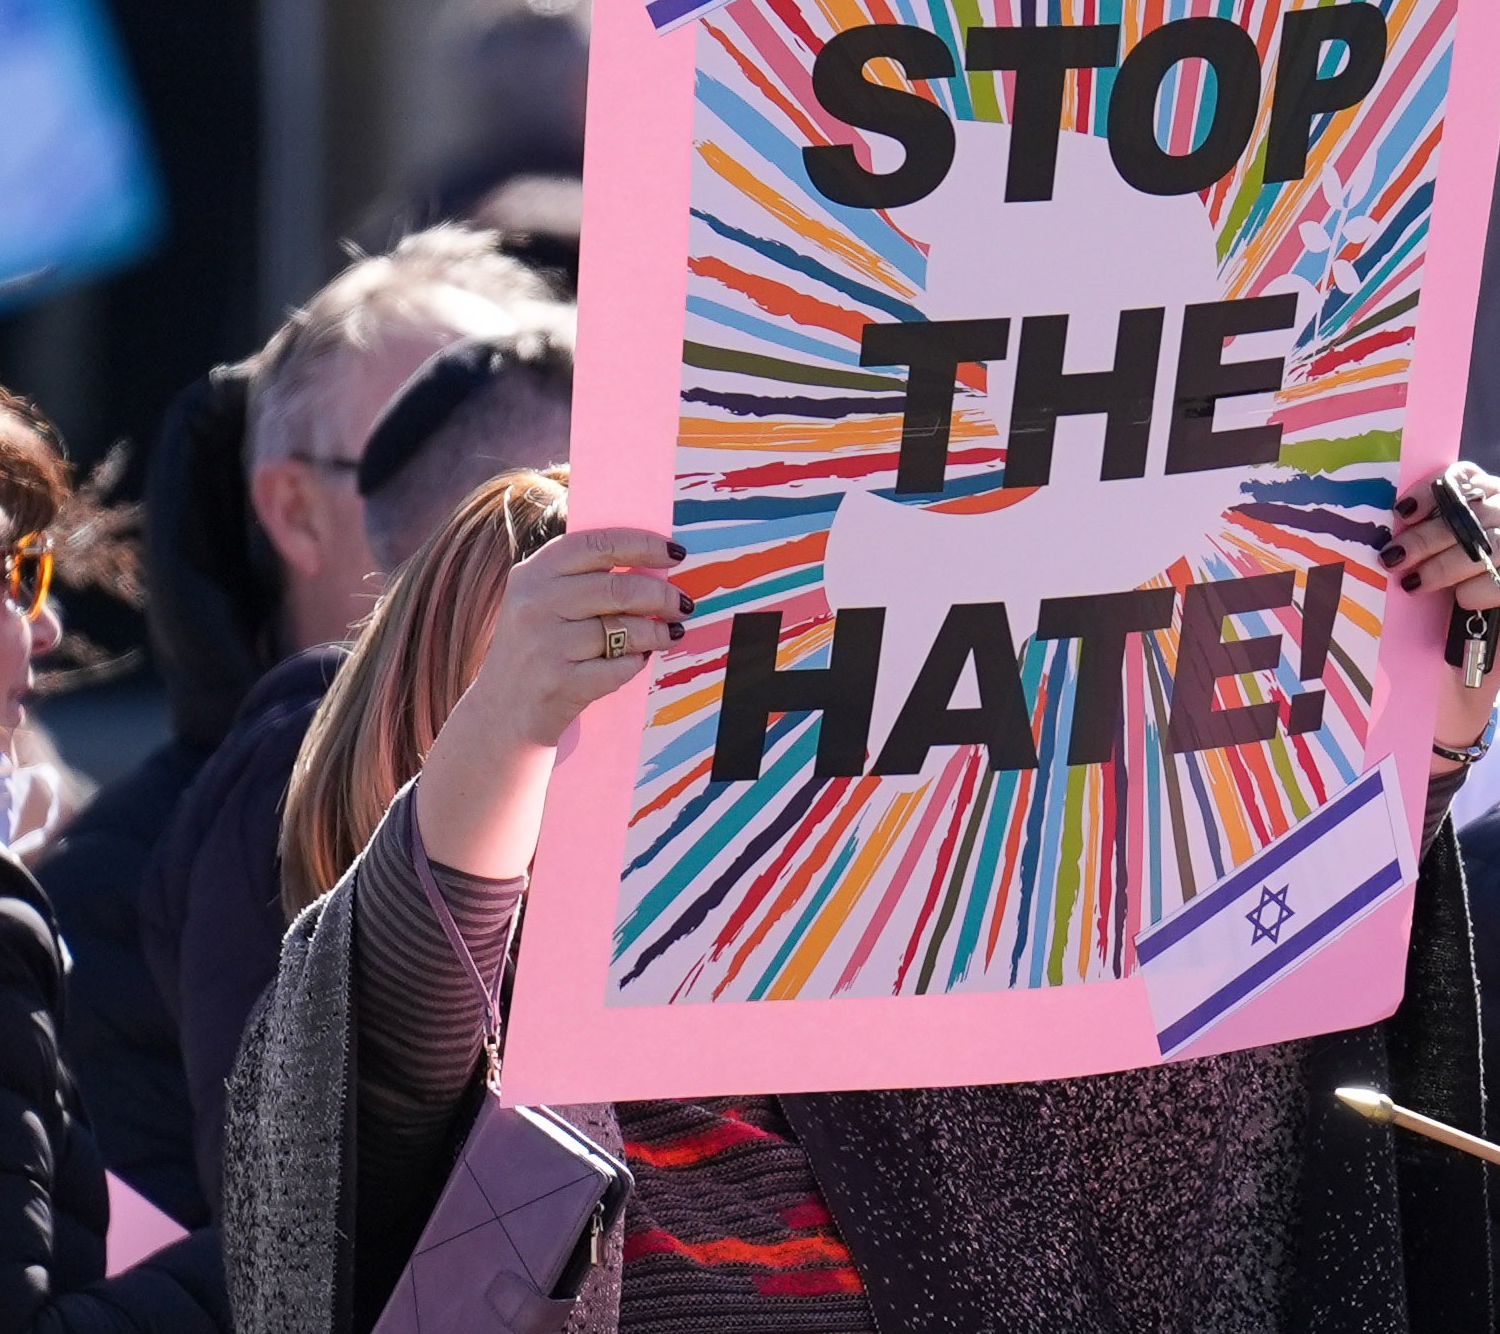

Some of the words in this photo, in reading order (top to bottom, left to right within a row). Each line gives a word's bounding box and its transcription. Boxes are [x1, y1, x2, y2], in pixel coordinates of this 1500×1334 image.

[802, 0, 1389, 211] STOP
[860, 292, 1300, 495] THE
[711, 562, 1346, 783] HATE!
